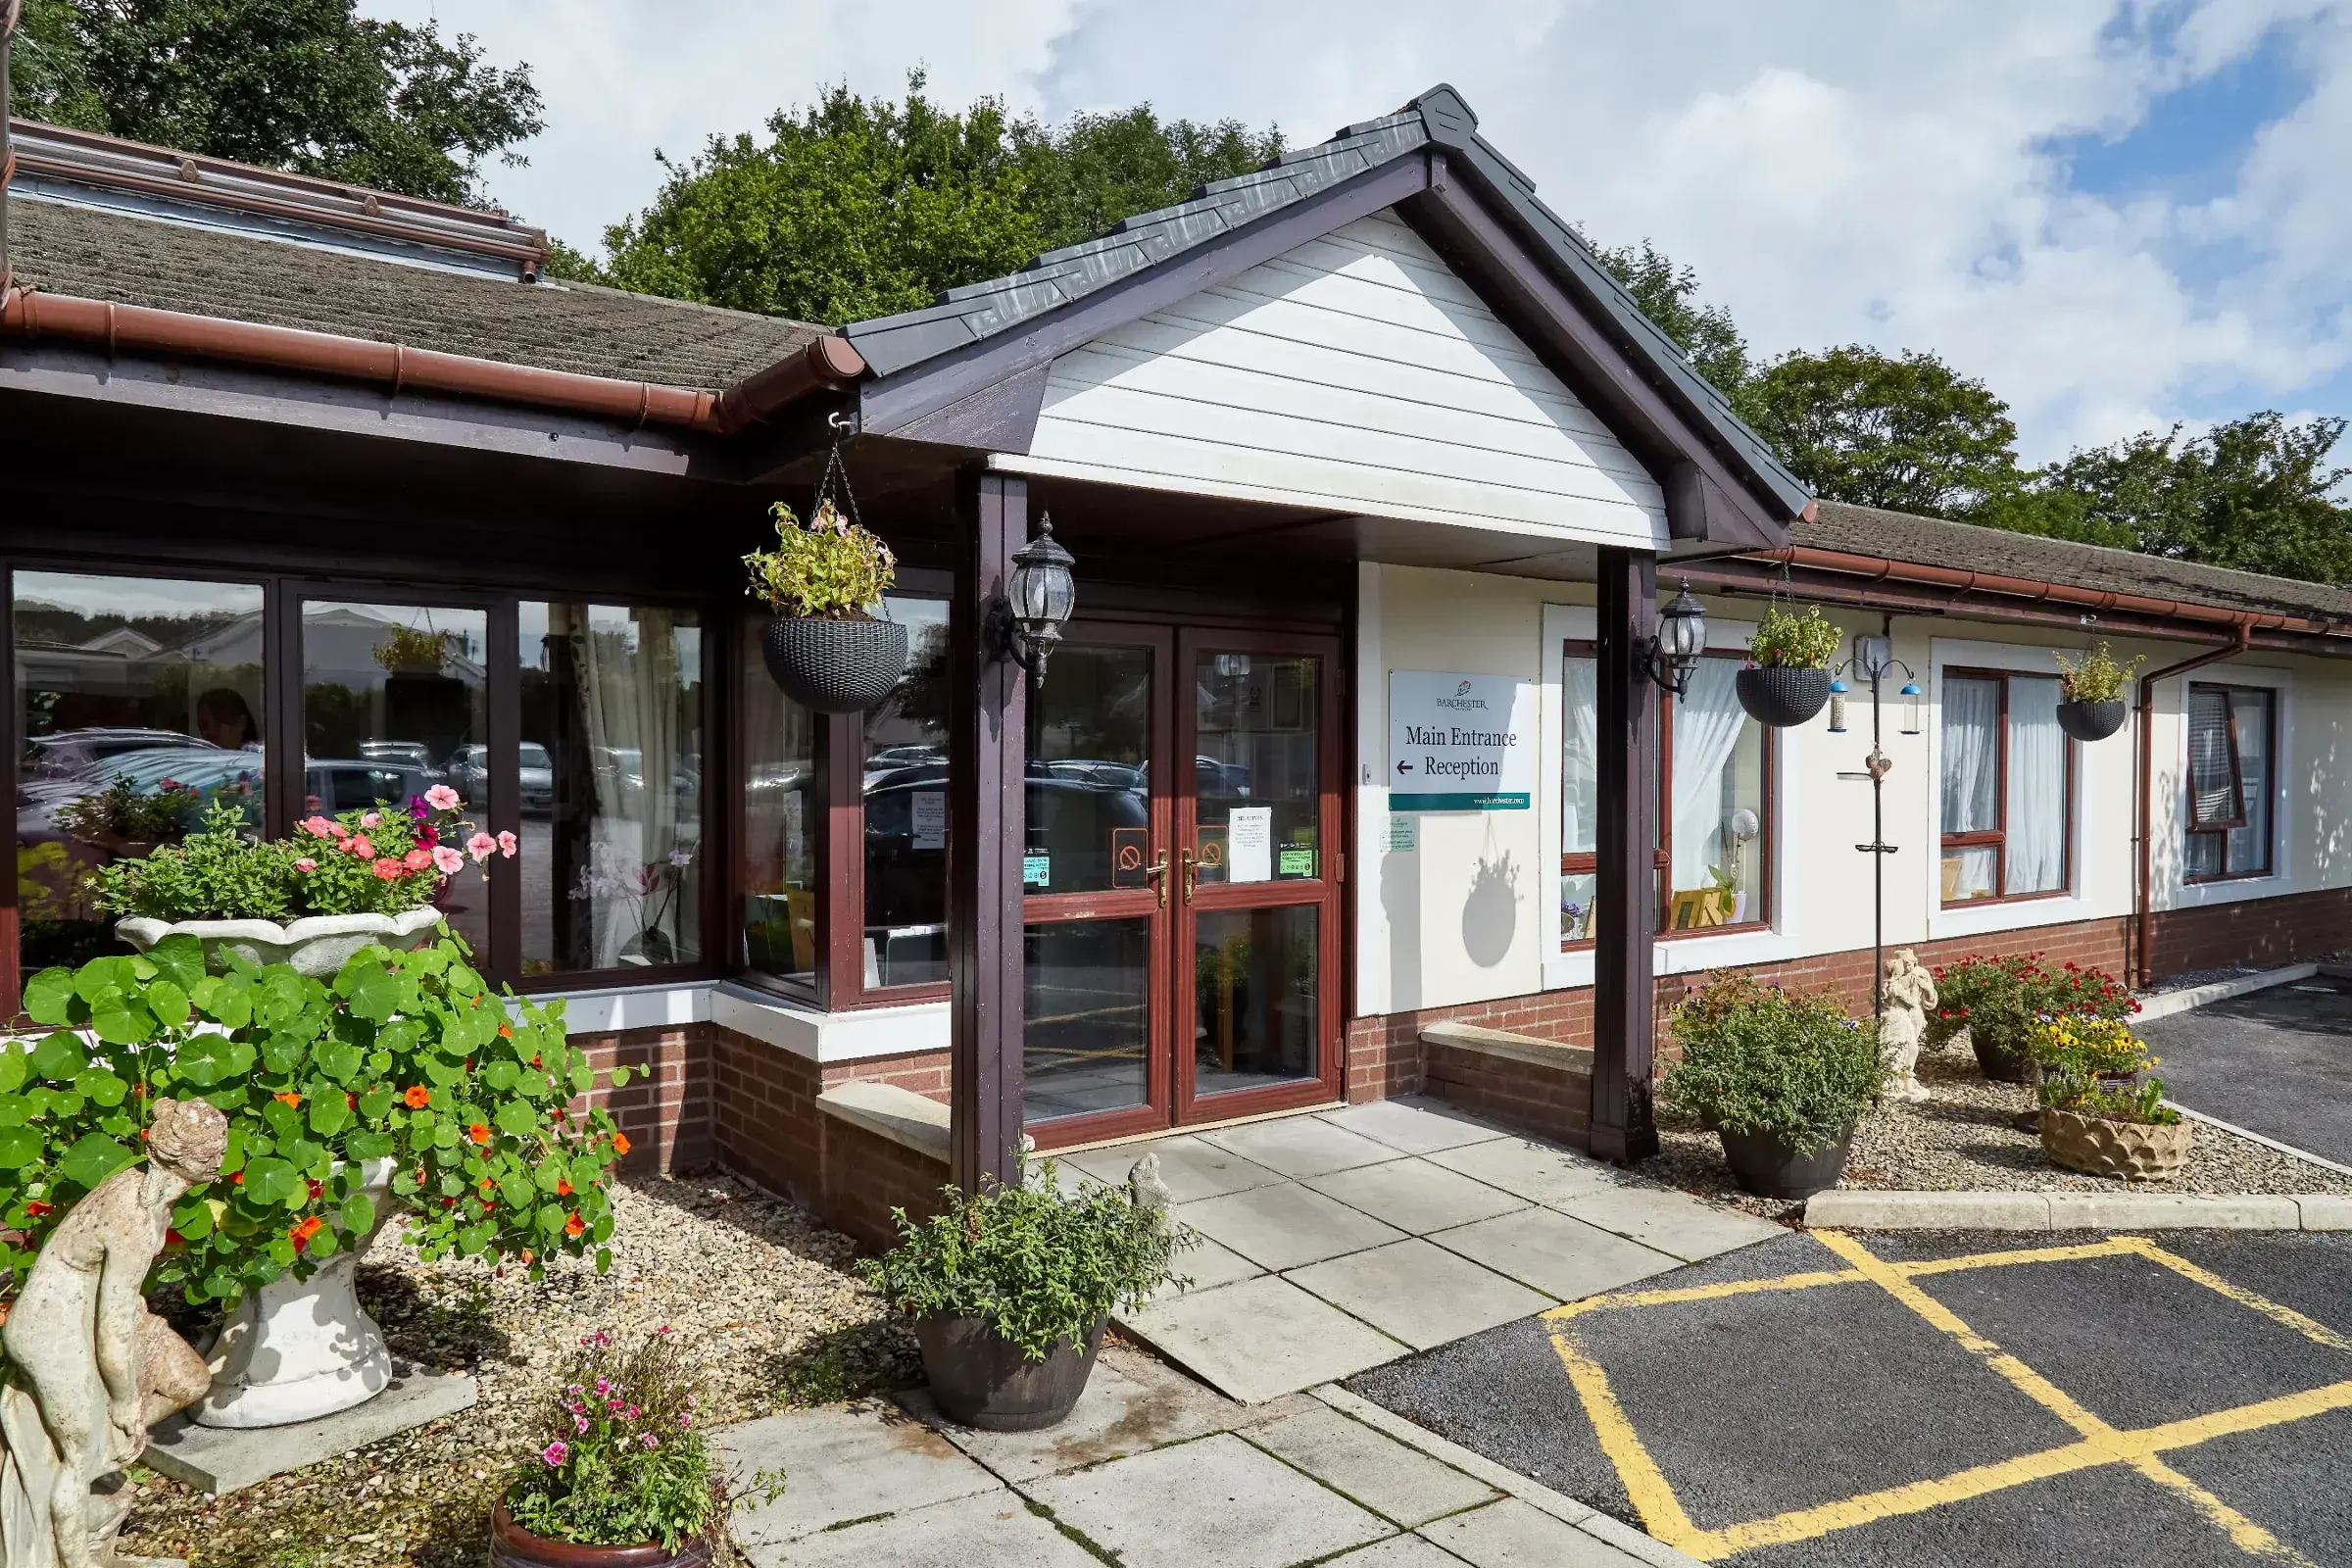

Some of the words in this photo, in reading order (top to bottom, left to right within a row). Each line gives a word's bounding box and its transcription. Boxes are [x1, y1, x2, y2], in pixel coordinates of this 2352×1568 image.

[1437, 698, 1489, 710] BARCHESTER
[1405, 725, 1446, 746] Main
[1450, 727, 1517, 747] Entrance
[1424, 756, 1499, 780] Reception
